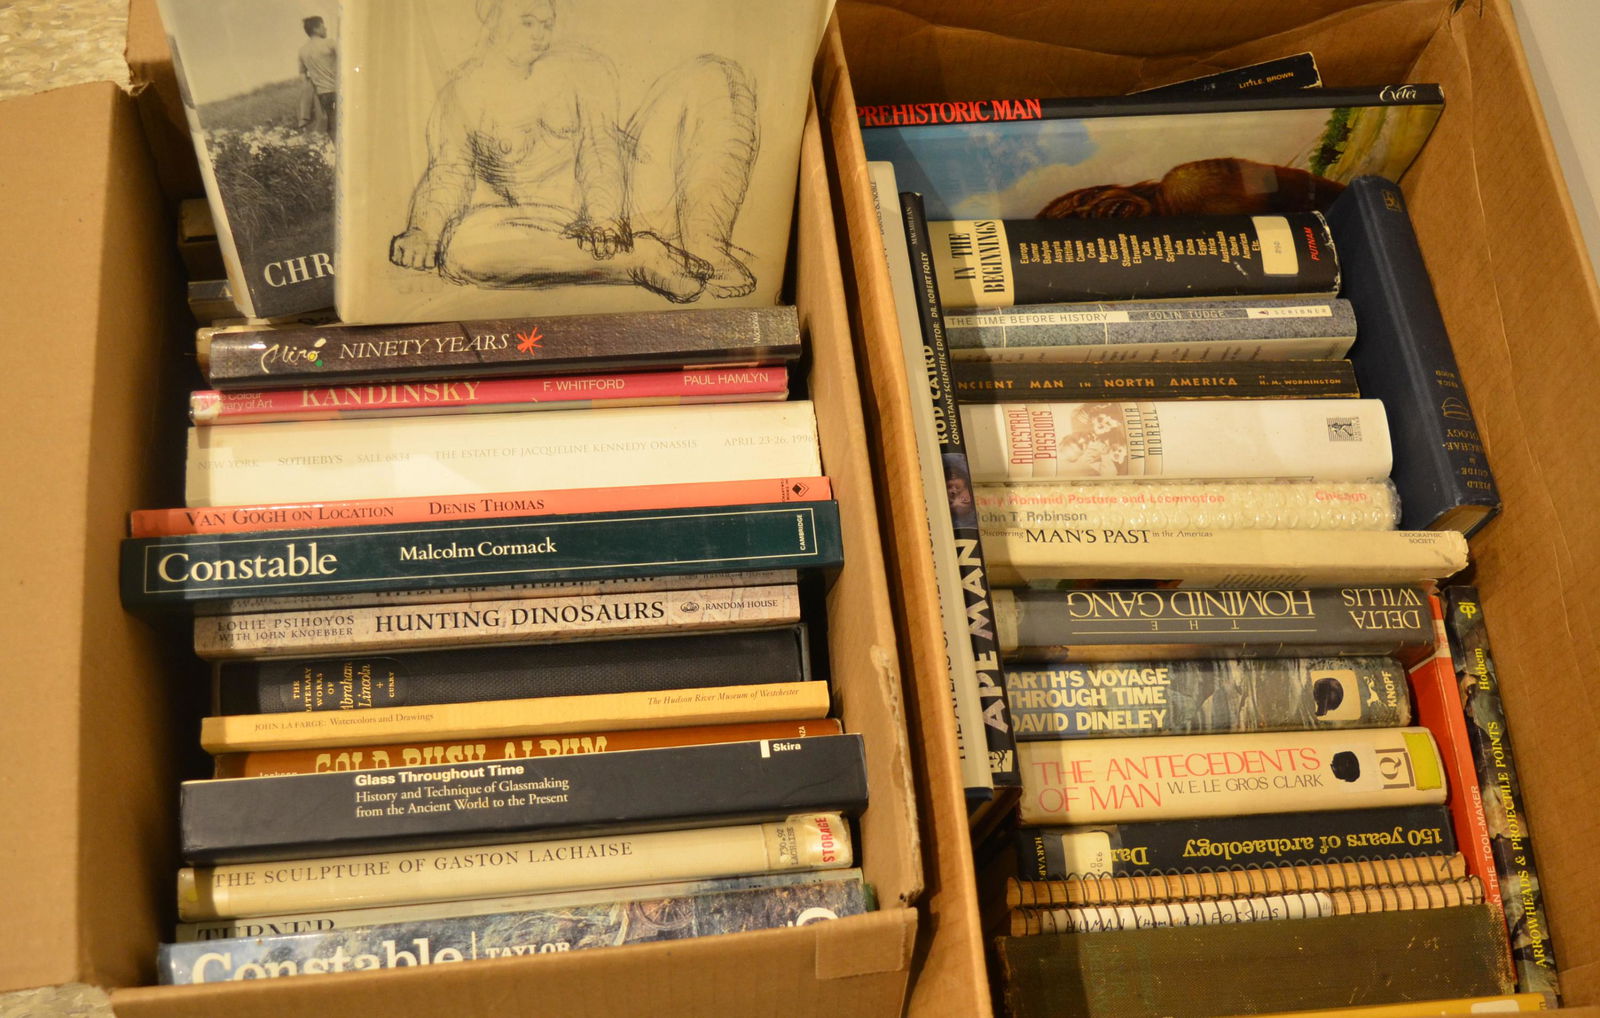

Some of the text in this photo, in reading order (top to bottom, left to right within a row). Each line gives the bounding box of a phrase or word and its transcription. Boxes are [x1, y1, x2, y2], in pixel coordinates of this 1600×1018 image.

[1266, 71, 1294, 84] BROWN
[1379, 84, 1417, 101] Exeter
[856, 99, 1041, 126] PREHISTORIC MAN
[906, 207, 918, 244] MACMILLAN
[948, 233, 976, 280] IN THE
[974, 221, 1005, 293] BEGINNINGS
[1304, 227, 1320, 261] PUTNAM
[951, 313, 1108, 326] THE TIME BEFORE HISTORY
[1148, 311, 1182, 320] COLIN
[1189, 310, 1225, 319] TUDGE
[339, 339, 431, 360] NINETY
[435, 333, 509, 352] YEARS
[920, 252, 960, 445] CONSULTANT SCIENTIFIC EDITOR: ROBERT FOLEY
[302, 372, 768, 408] KANDINSKY F. WHITFORD PAUL HAMLYN
[958, 377, 1238, 390] NCIENT MAN NORTH AMERICA
[724, 436, 756, 448] APRIL
[1008, 407, 1033, 465] ANCESTRAL
[1032, 410, 1057, 460] PASSIONS
[1125, 407, 1144, 460] VIRGINIA
[1144, 409, 1163, 456] MORELL
[436, 440, 698, 460] THE ESTATE JACQUELINE KENNEDY ONASSIS
[1068, 494, 1117, 505] Posture
[1122, 493, 1146, 504] and
[1150, 493, 1224, 504] Locomotion
[185, 498, 544, 528] VAN GOGH ON LOCATION DENIS THOMAS
[1010, 512, 1022, 522] T.
[1026, 511, 1087, 522] Robinson
[798, 514, 806, 551] CAMBRIDGE
[980, 529, 1213, 544] Discovering MAN'S PAST Americas
[158, 537, 558, 584] Constable Malcolm Cormack
[704, 599, 778, 610] RANDOM HOUSE
[1066, 590, 1316, 619] HOMINID GANG
[1342, 588, 1422, 607] WILLIS
[217, 614, 354, 631] LOUIE PSIHOYOS
[376, 601, 664, 633] HUNTING DINOSAURS
[1348, 610, 1422, 630] DELTA
[218, 627, 354, 642] WITH JOHN KNOEBBER
[956, 539, 1009, 734] APE MAN
[328, 681, 334, 694] OF
[358, 664, 372, 707] Lincoln
[1006, 668, 1170, 688] ARTH'S VOYAGE
[1381, 670, 1397, 707] KNOPF
[648, 688, 800, 705] The Hudson River Museum Westchester
[1007, 686, 1167, 708] THROUGH TIME
[330, 714, 376, 727] Watercolors
[378, 714, 394, 724] and
[396, 712, 434, 724] Drawings
[1011, 710, 1167, 733] DAVID DINELEY
[772, 742, 802, 752] Skira
[355, 764, 524, 786] Glass Throughout Time
[1032, 748, 1320, 786] THE ANTECEDENTS
[356, 777, 569, 804] History and Technique of Glassmaking
[1226, 774, 1324, 792] GROS CLARK
[356, 792, 568, 818] from the Ancient World to the Present
[1040, 782, 1162, 812] OF MAN
[1472, 785, 1493, 866] TOOL-MAKER
[814, 818, 836, 862] STORAGE
[1182, 828, 1442, 861] 150 years of archaeology
[1488, 721, 1546, 969] ARROWHEADS PROJECTILE POINTS
[213, 842, 633, 888] THE SCULPTURE OF GASTON LACHAISE
[1490, 868, 1498, 892] THE
